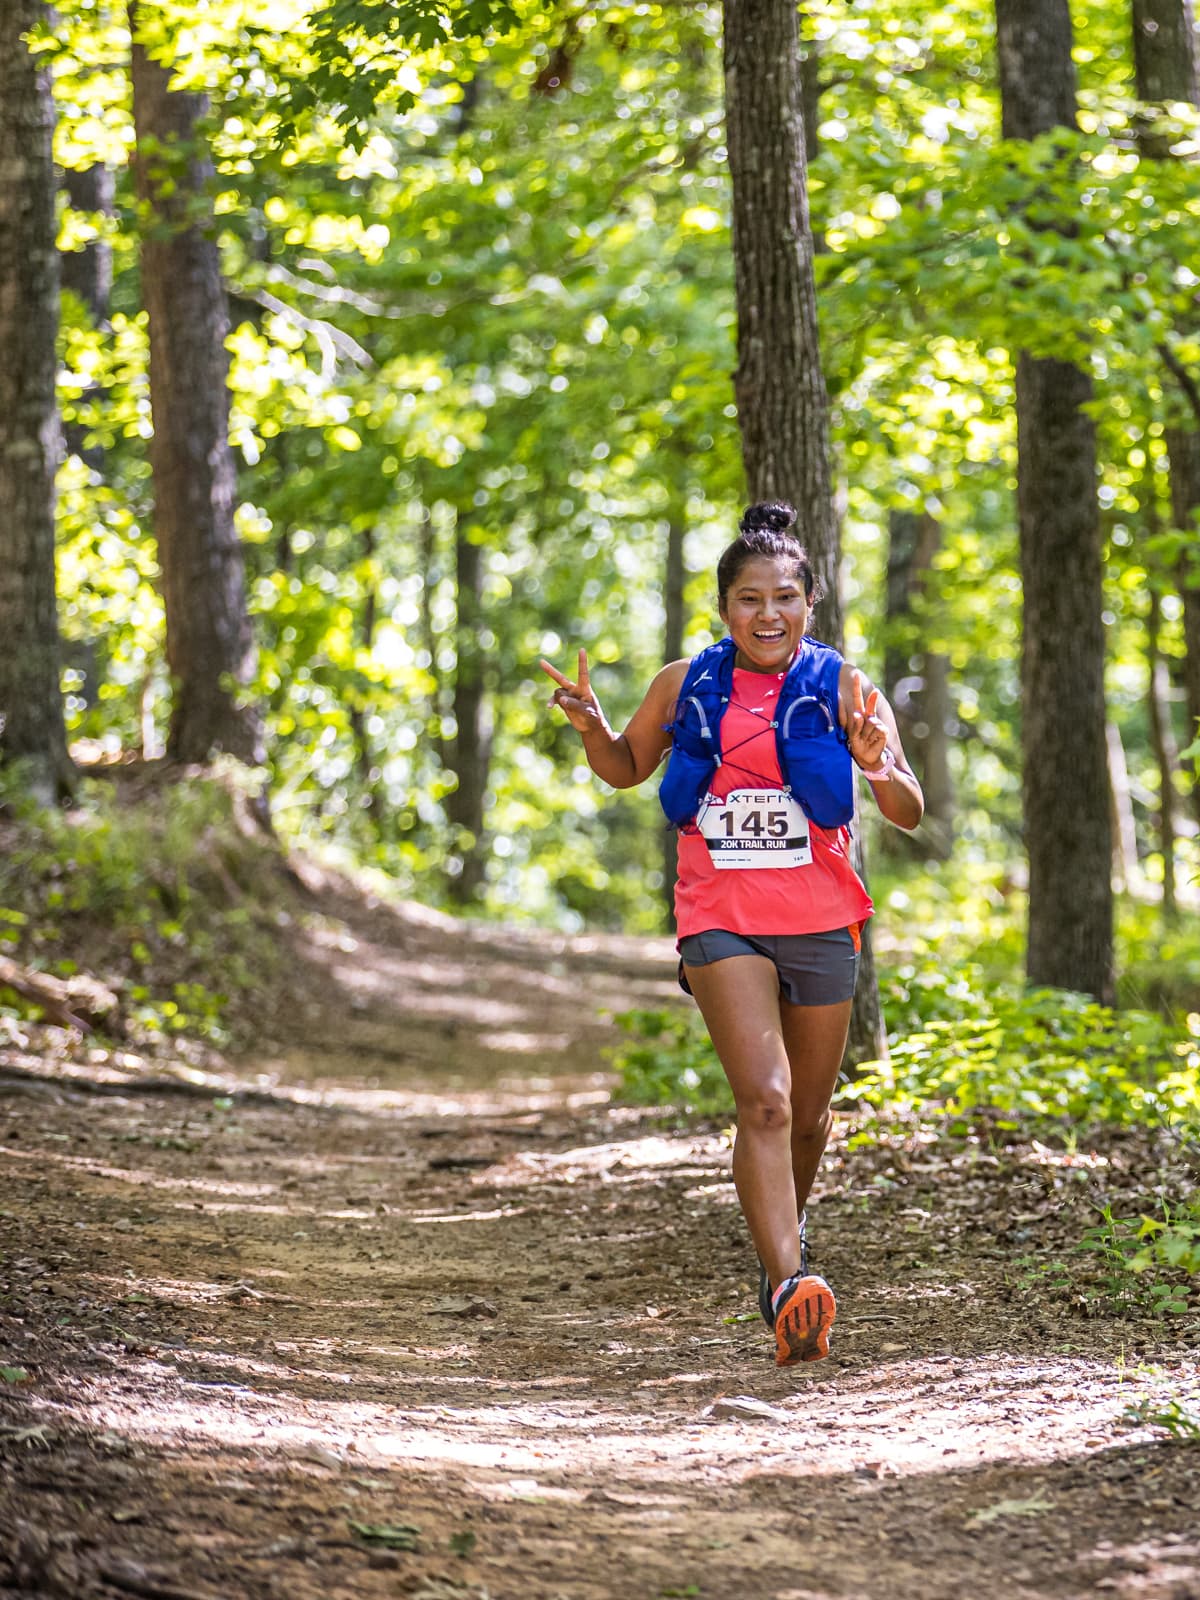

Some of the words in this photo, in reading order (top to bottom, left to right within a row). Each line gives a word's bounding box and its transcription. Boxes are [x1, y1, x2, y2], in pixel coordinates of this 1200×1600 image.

[720, 811, 788, 837] 145
[721, 840, 738, 849] 20K
[739, 840, 765, 849] TRAIL
[766, 840, 786, 849] RUN
